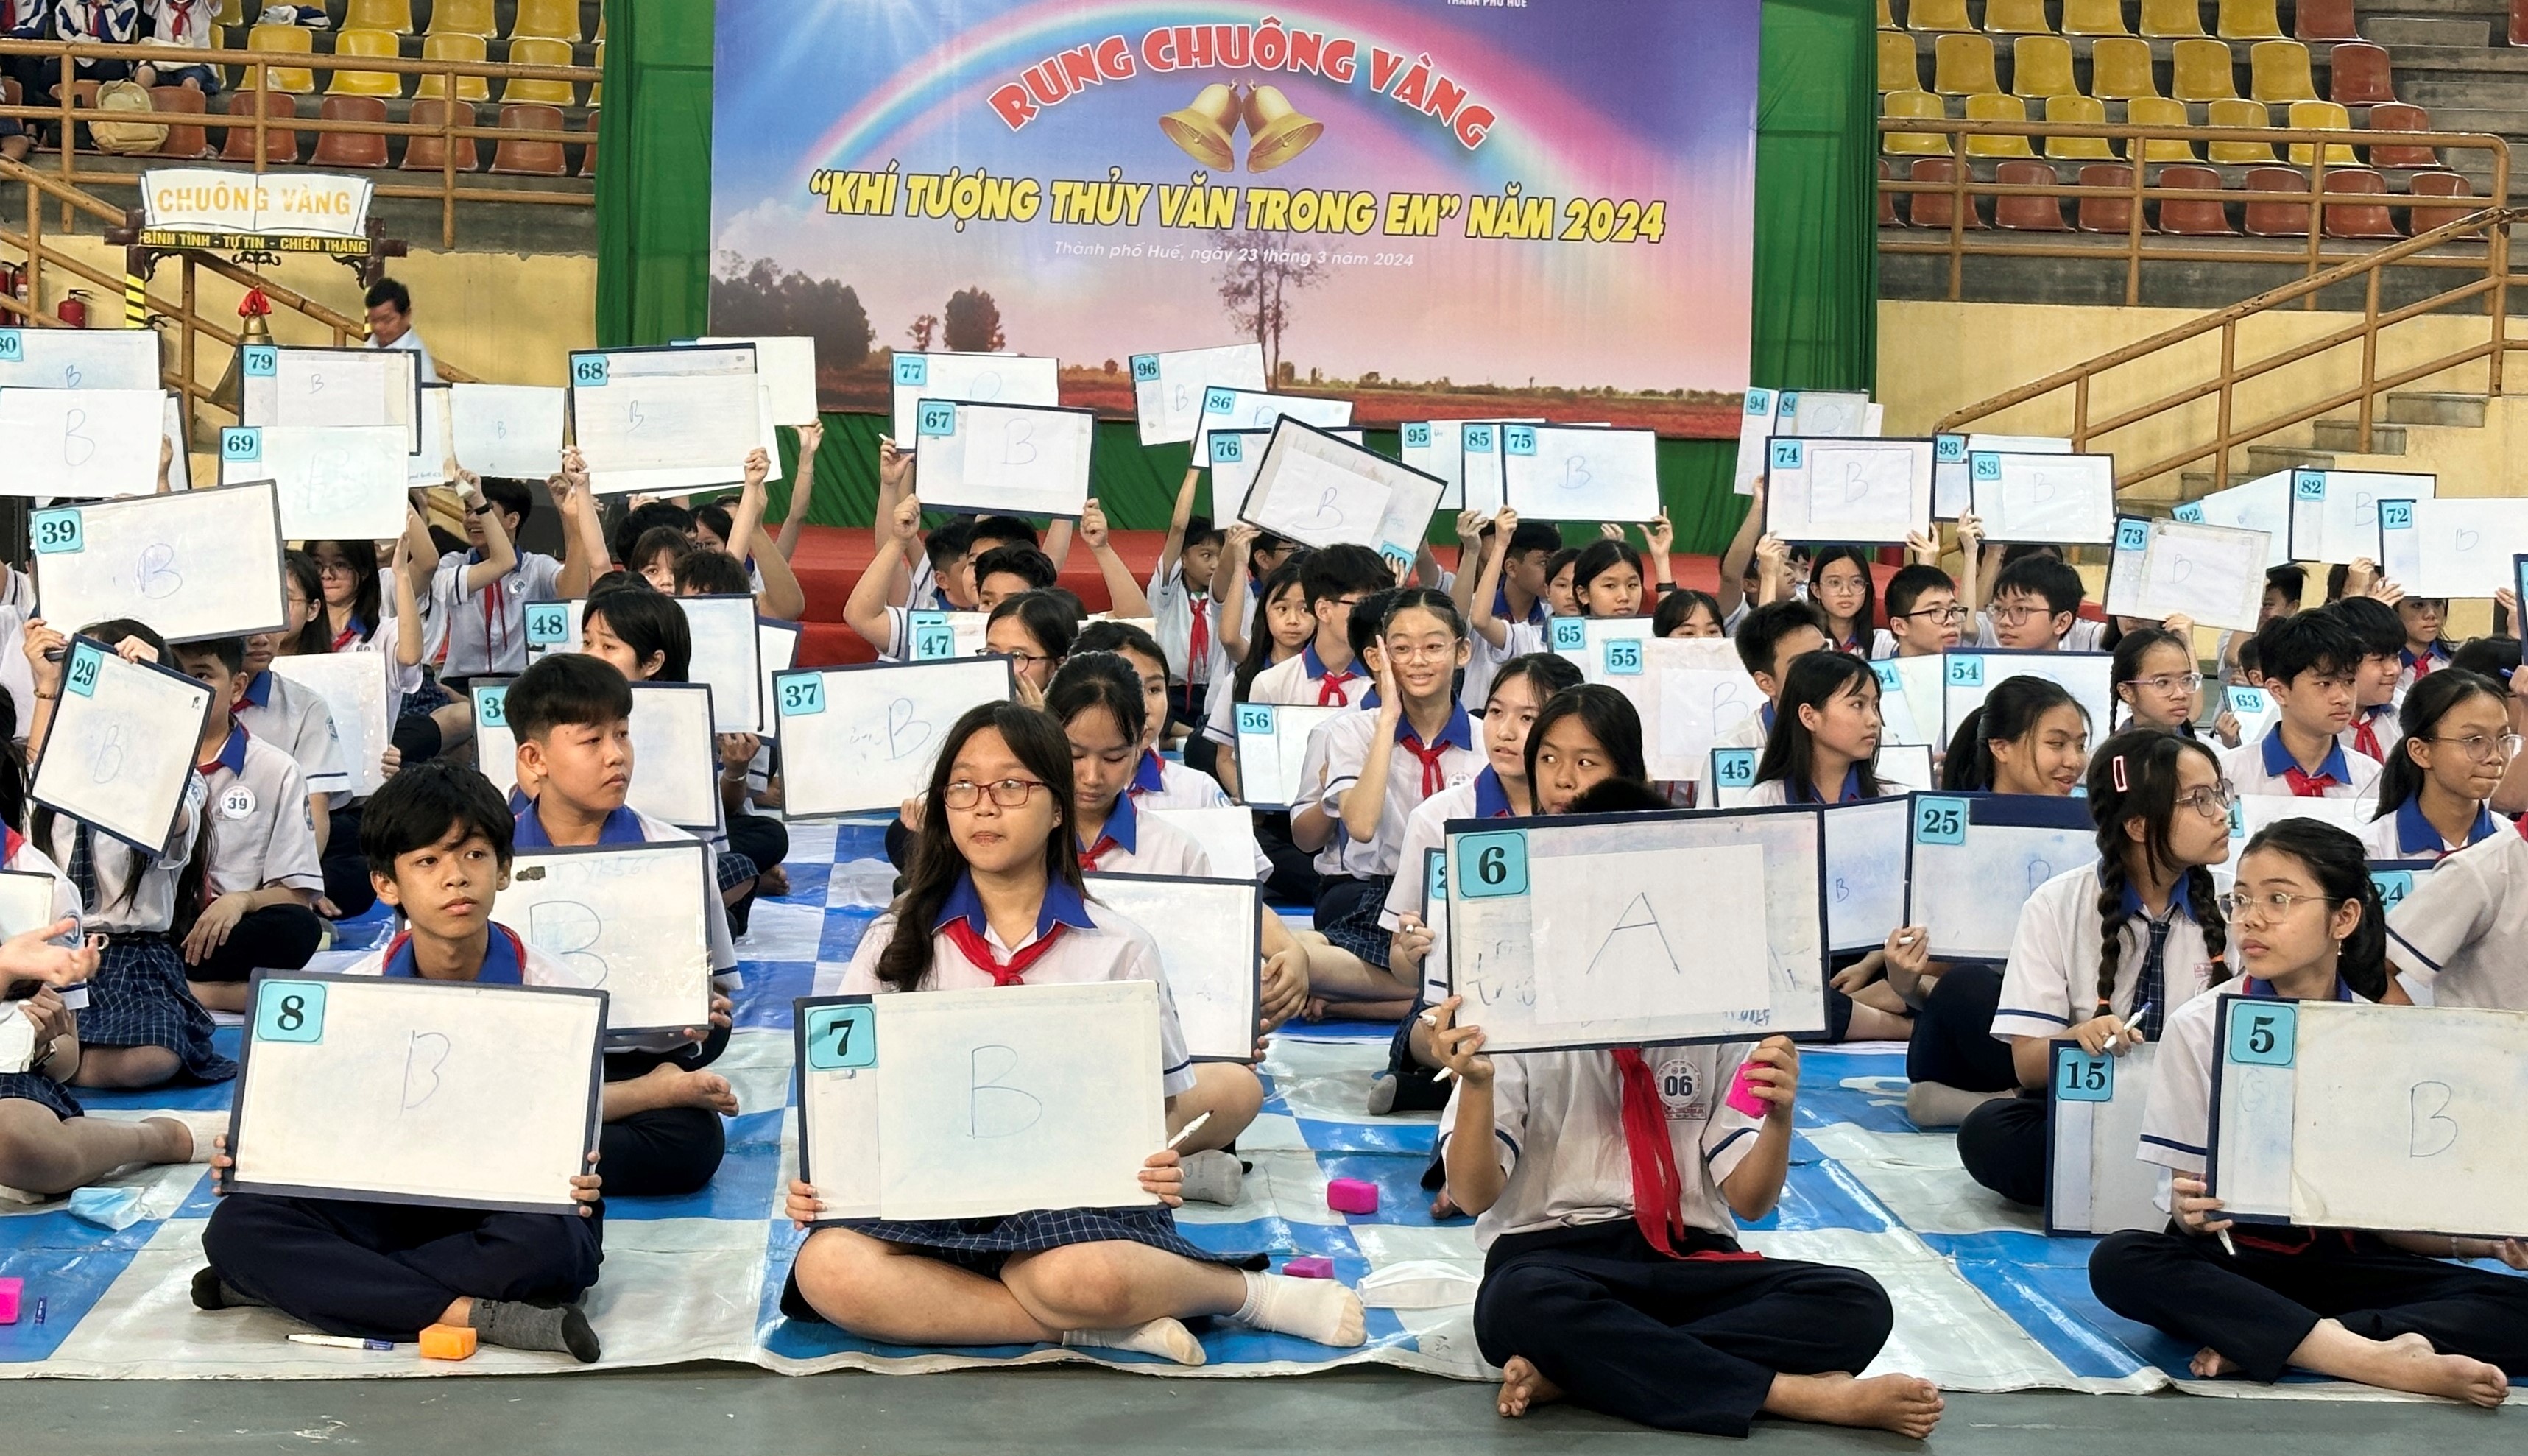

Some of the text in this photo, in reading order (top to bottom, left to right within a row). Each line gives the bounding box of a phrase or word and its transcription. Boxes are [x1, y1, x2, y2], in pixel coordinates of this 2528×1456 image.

[988, 16, 1496, 150] RUNG CHUÔNG VÀNG
[157, 181, 350, 215] CHUÔNG VÀNG
[810, 160, 1666, 244] “KHÍ TƯỢNG THỦY VĂN TRONG EM” NĂM 2024
[243, 236, 265, 249] TIN
[1054, 240, 1414, 267] Thành phố Huế, ngày 23 tháng 3 năm 2024
[249, 353, 273, 370] 79
[577, 363, 604, 380] 68
[900, 364, 922, 379] 77
[1137, 364, 1157, 376] 96
[66, 364, 82, 388] B
[310, 374, 324, 394] B
[1176, 384, 1189, 411] B
[1209, 397, 1232, 410] 86
[1750, 396, 1765, 411] 94
[497, 420, 506, 439] B
[925, 412, 950, 428] 67
[65, 409, 95, 466] B
[227, 434, 253, 453] 69
[1002, 418, 1037, 465] B
[1408, 425, 1428, 442] 95
[1468, 430, 1489, 447] 85
[1509, 435, 1533, 449] 75
[1216, 442, 1238, 456] 76
[1776, 448, 1798, 463] 74
[1939, 441, 1957, 456] 93
[1558, 456, 1592, 489] B
[1977, 462, 1998, 476] 83
[1845, 461, 1868, 503] B
[2033, 473, 2055, 503] B
[2301, 480, 2321, 495] 82
[2180, 508, 2200, 522] 92
[2386, 507, 2409, 523] 72
[42, 520, 76, 544] 39
[2123, 529, 2144, 545] 73
[135, 543, 183, 599] B
[2173, 554, 2192, 584] B
[532, 615, 563, 635] 48
[1558, 626, 1581, 643] 65
[921, 635, 949, 655] 47
[1611, 648, 1637, 666] 55
[75, 660, 95, 686] 29
[1952, 662, 1979, 680] 54
[785, 683, 818, 707] 37
[2236, 693, 2260, 708] 63
[884, 698, 932, 761] B
[1242, 712, 1268, 728] 56
[1721, 760, 1750, 779] 45
[227, 797, 247, 810] 39
[1924, 810, 1959, 835] 25
[1478, 847, 1508, 885] 6
[1836, 877, 1850, 903] B
[2376, 883, 2405, 906] 24
[1586, 891, 1681, 975] A
[277, 994, 305, 1031] 8
[828, 1019, 854, 1056] 7
[2249, 1017, 2275, 1053] 5
[400, 1030, 451, 1117] B
[2066, 1060, 2106, 1091] 15
[966, 1045, 1043, 1140] B
[1664, 1075, 1692, 1096] 06
[2409, 1080, 2459, 1158] B
